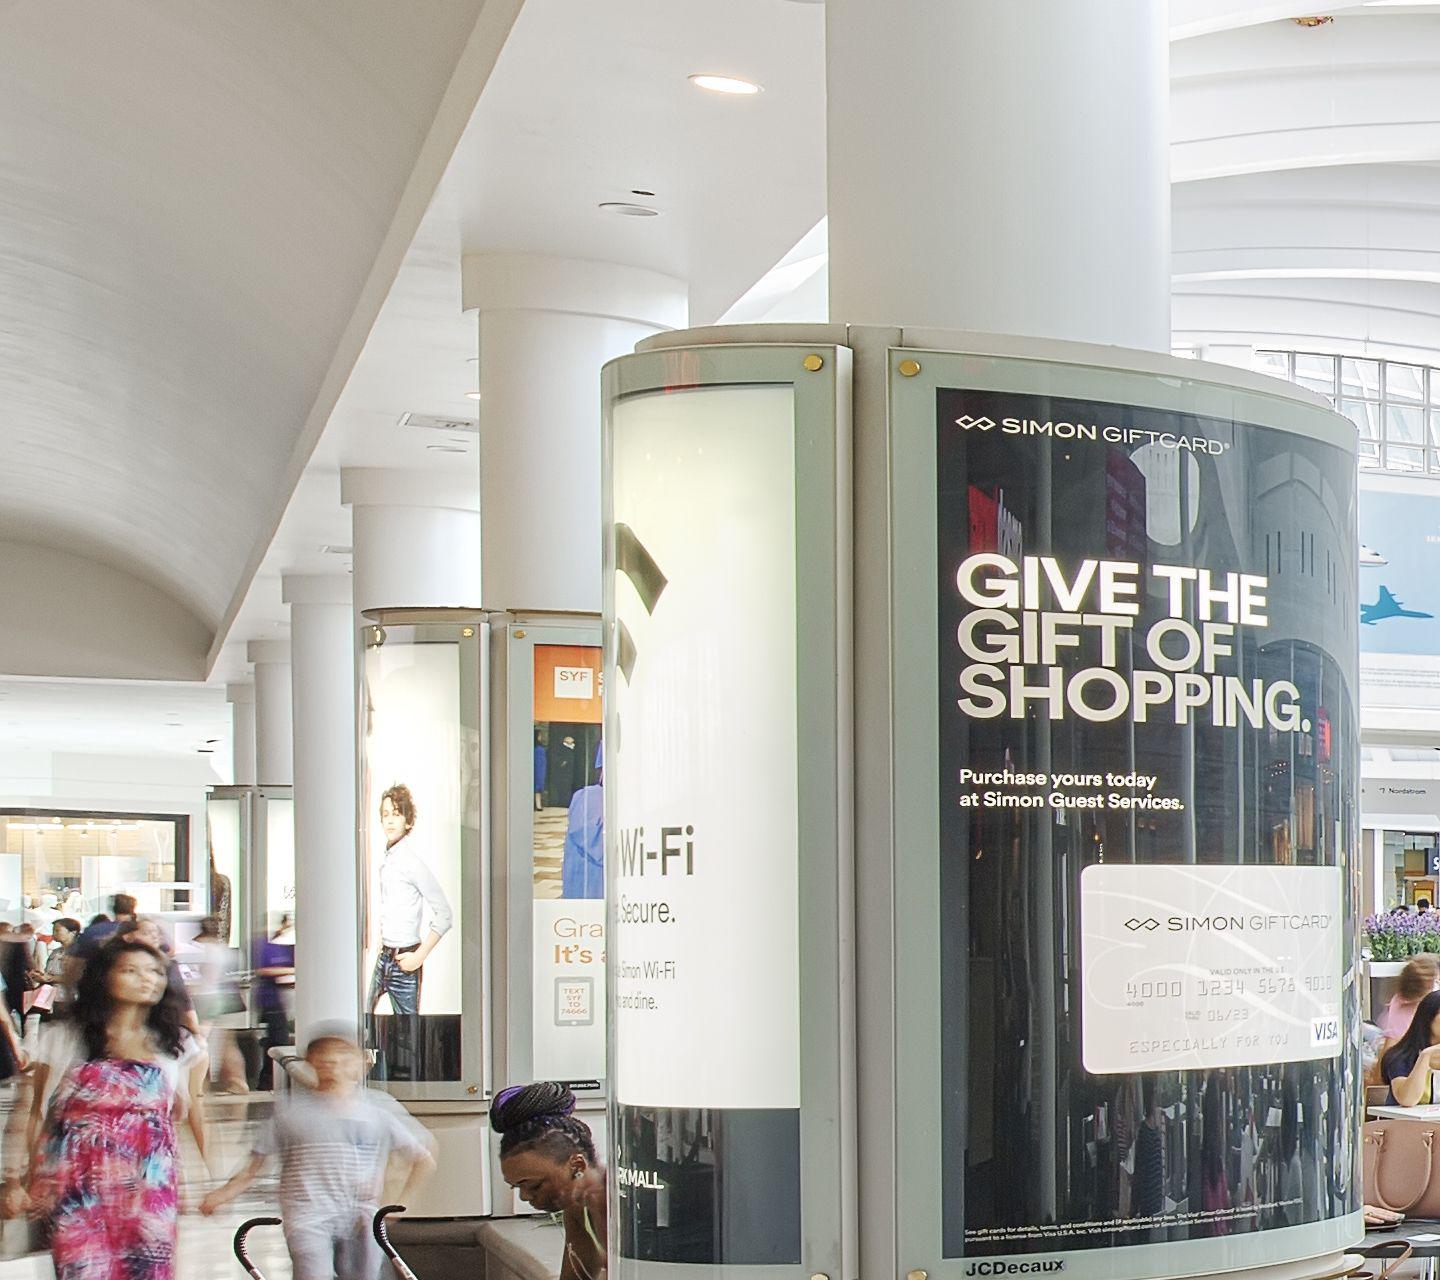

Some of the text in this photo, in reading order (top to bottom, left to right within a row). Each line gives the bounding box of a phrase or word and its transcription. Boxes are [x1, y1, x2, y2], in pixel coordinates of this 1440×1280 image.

[1001, 417, 1097, 440] SIMON
[956, 552, 1269, 627] GIVE THE
[957, 608, 1235, 674] GIFT OF
[560, 670, 588, 681] SYF
[957, 663, 1312, 733] SHOPPING.
[959, 769, 1157, 790] Purchase yours today
[959, 792, 1185, 811] at Simon Guest Services.
[620, 824, 695, 877] Wi-Fi
[621, 893, 676, 924] Secure.
[1167, 916, 1245, 932] SIMON
[643, 960, 676, 980] Wi-Fi
[1126, 980, 1183, 999] 4000
[1197, 979, 1245, 997] 1234
[1313, 1021, 1338, 1041] VISA
[1128, 1032, 1289, 1055] ESPECIALLY FOR YOU
[965, 1259, 1065, 1277] JCDecaux
